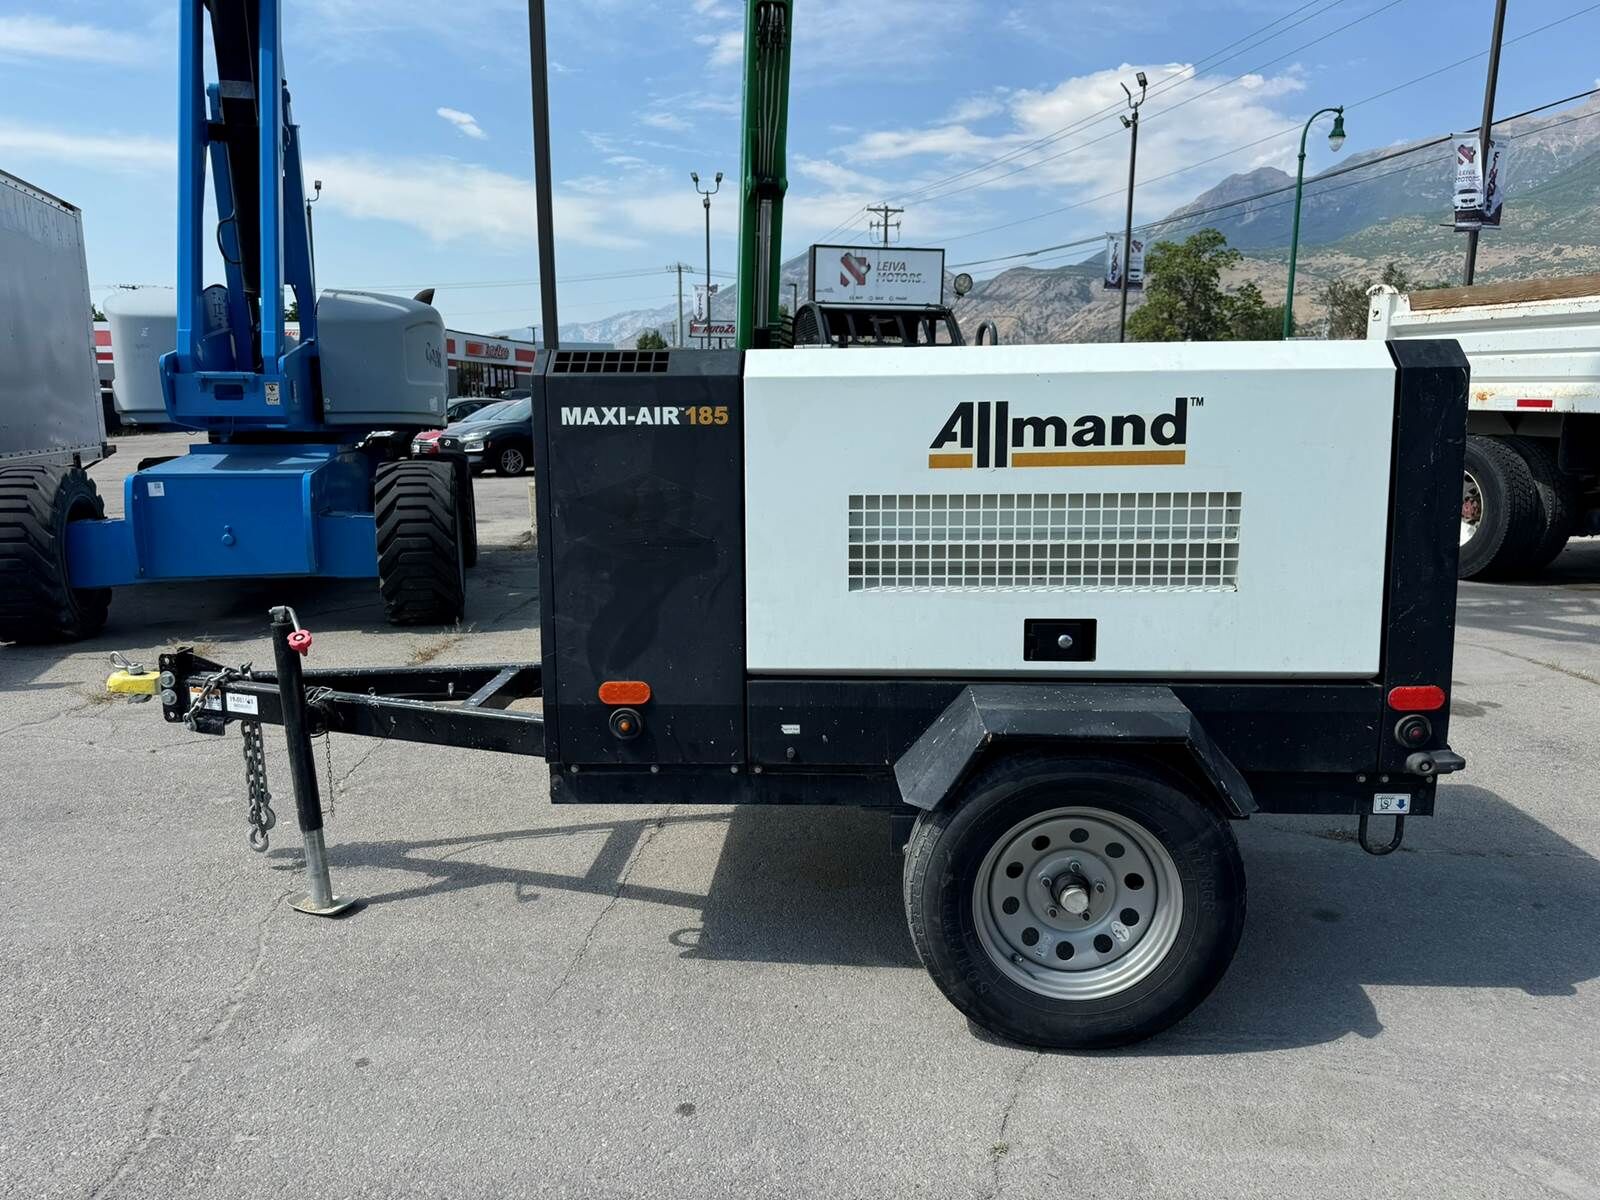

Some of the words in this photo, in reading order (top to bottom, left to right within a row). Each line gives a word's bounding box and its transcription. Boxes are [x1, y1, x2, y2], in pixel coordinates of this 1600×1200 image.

[876, 261, 907, 272] LEIVA
[875, 272, 923, 284] MOTORS
[685, 405, 729, 426] 185
[928, 397, 1188, 469] Allmand
